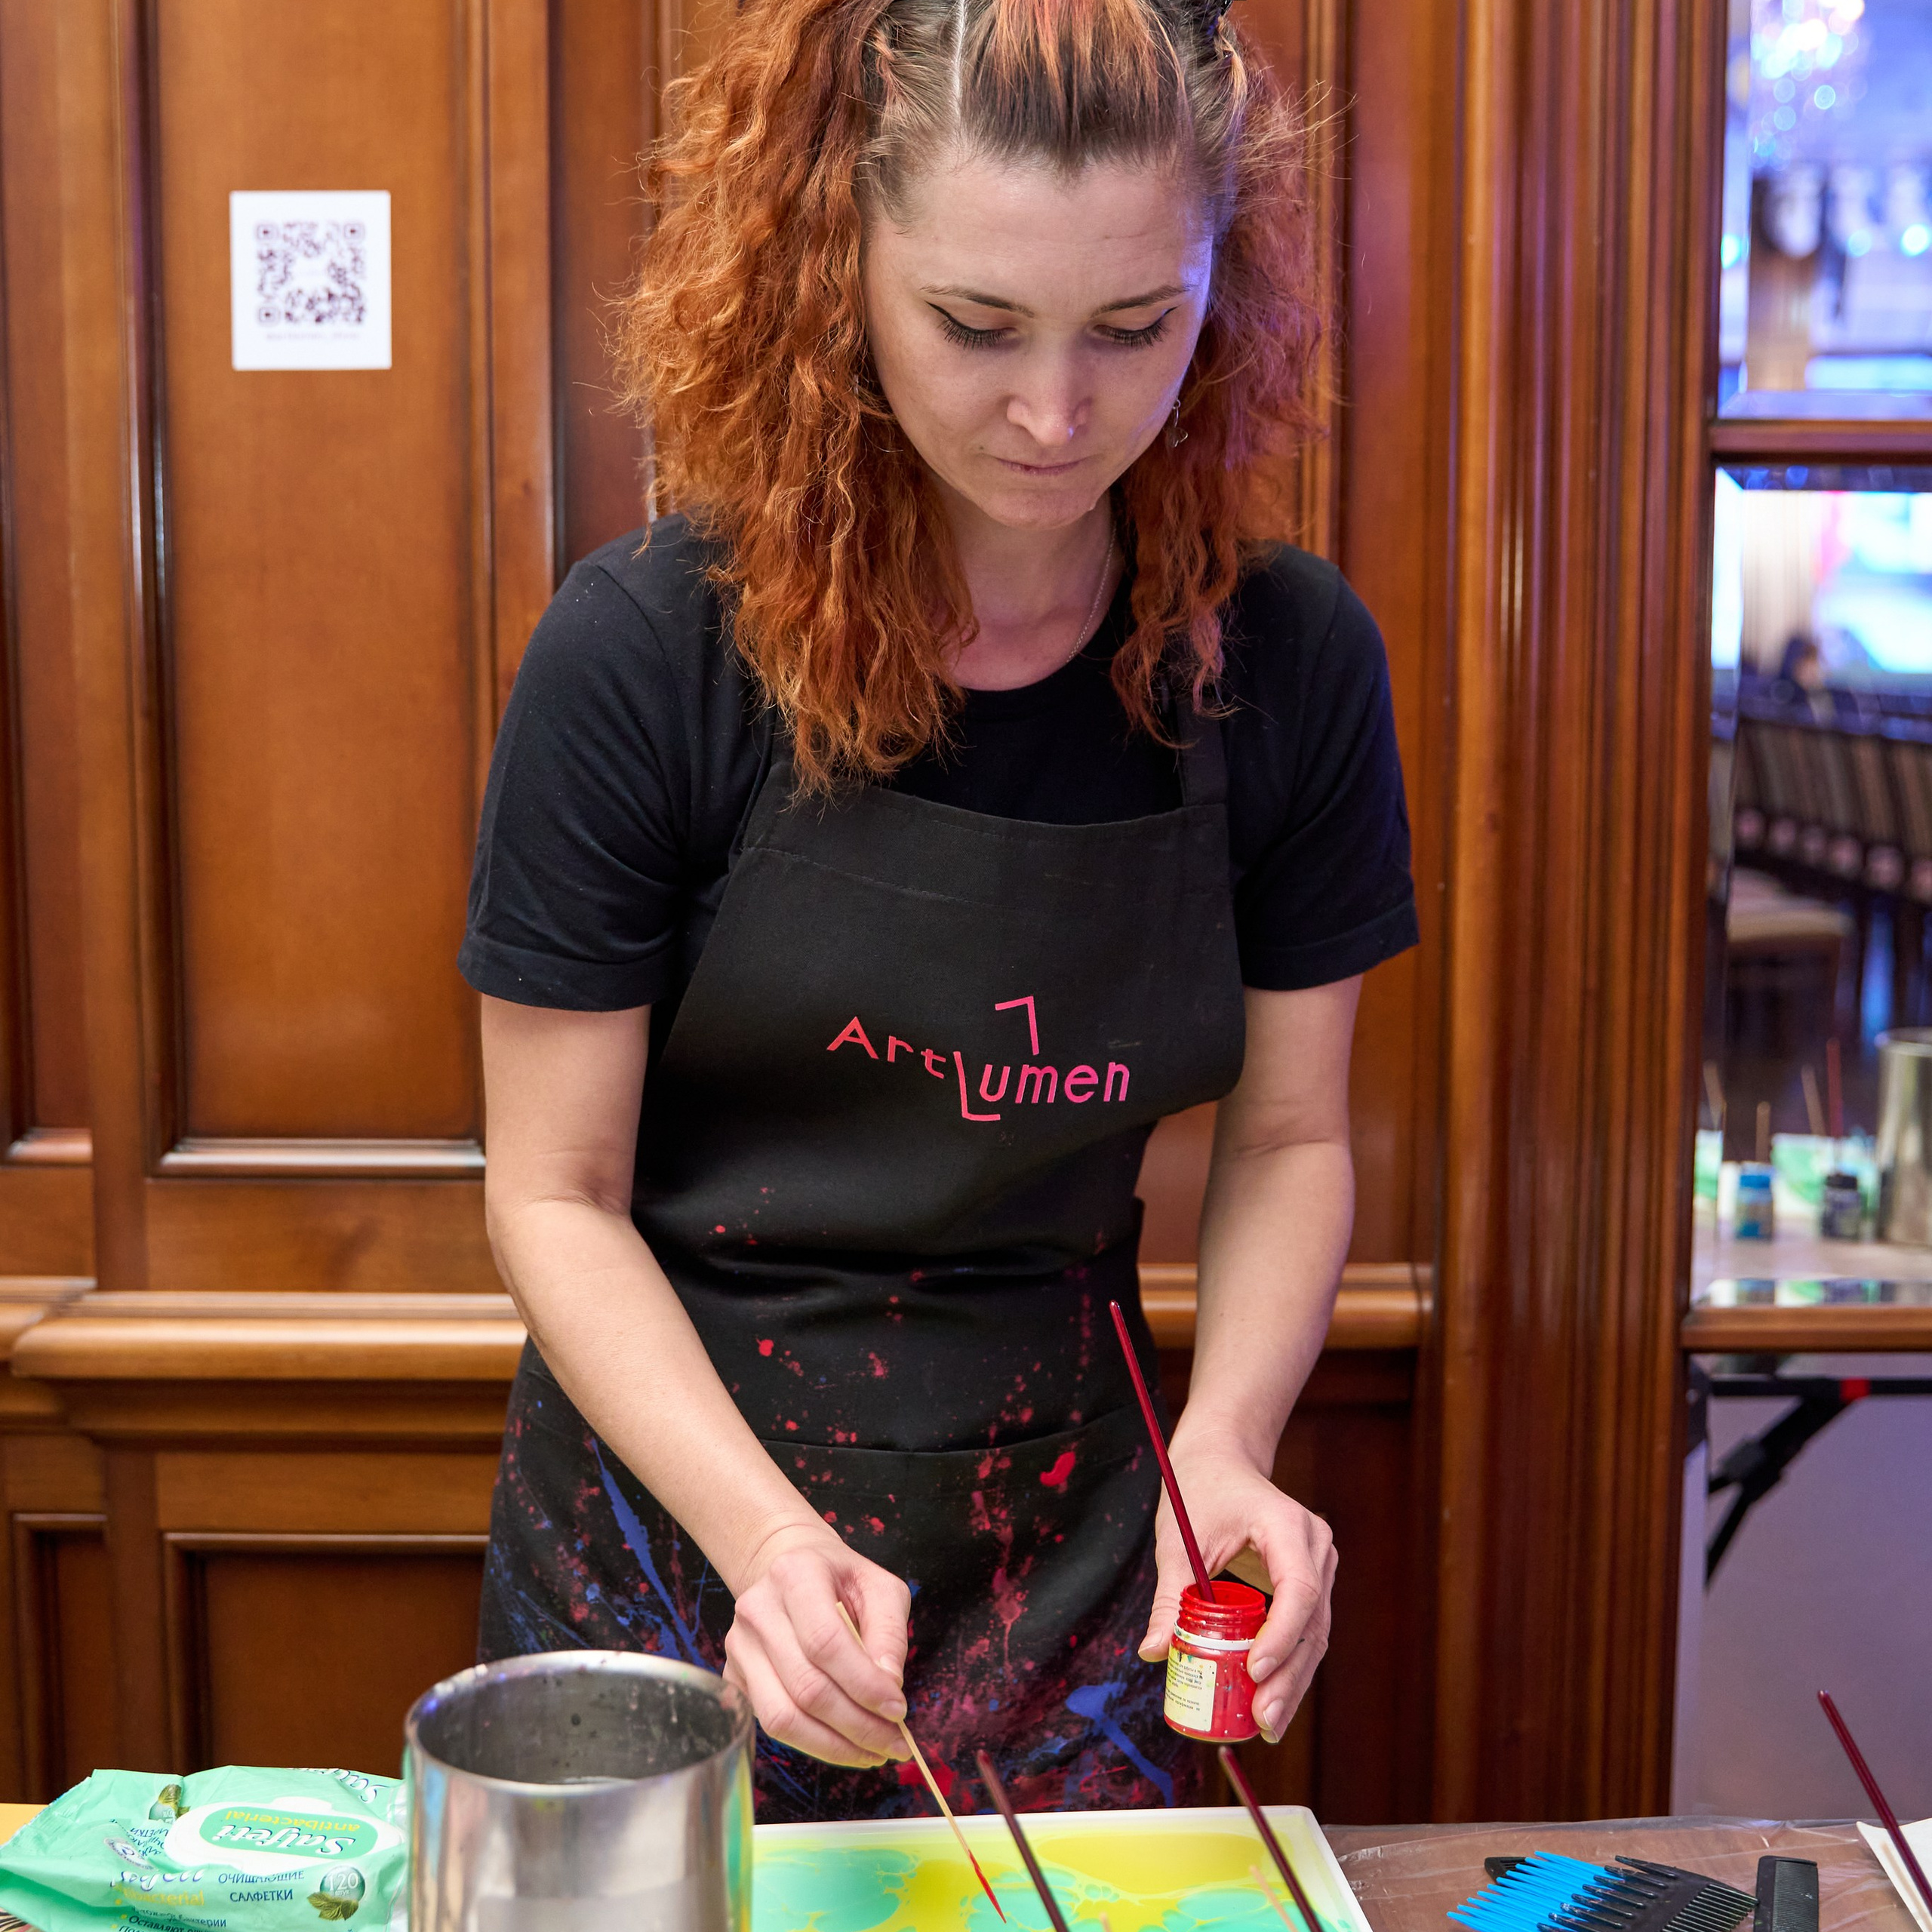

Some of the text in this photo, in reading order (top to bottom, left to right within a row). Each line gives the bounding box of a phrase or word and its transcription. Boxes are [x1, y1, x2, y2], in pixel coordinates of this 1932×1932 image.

[225, 1810, 361, 1832] antibacterial
[211, 1824, 357, 1856] Salfeti
[327, 1872, 359, 1891] 120
[229, 1888, 294, 1903] САЛФЕТКИ
